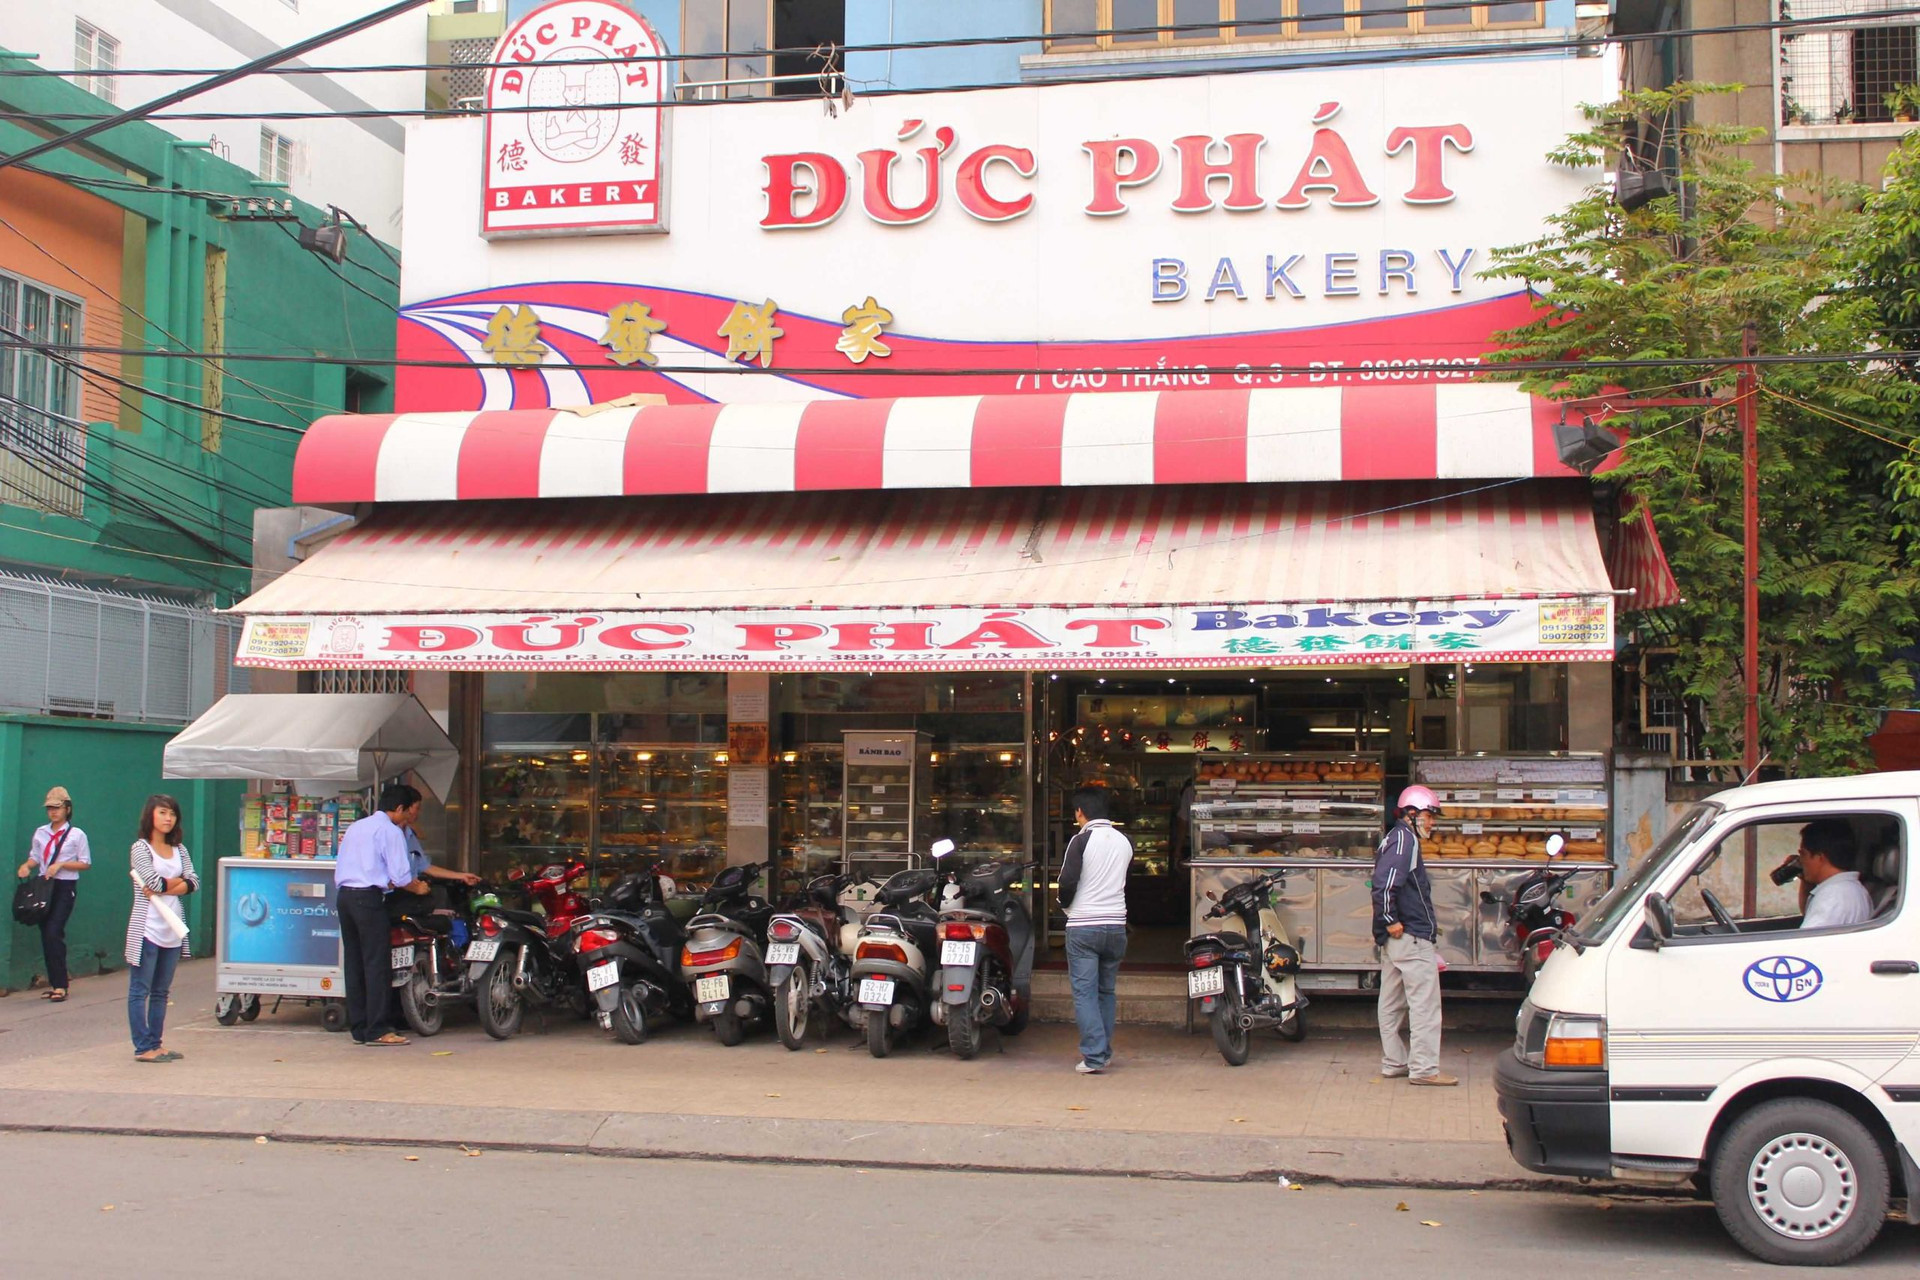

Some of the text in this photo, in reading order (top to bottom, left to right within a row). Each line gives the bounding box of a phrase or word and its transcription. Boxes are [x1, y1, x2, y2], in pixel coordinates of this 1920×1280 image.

[501, 16, 649, 94] ĐỨC PHÁT
[497, 139, 528, 172] 德
[618, 132, 648, 166] 發
[759, 101, 1476, 230] ĐỨC PHÁT
[495, 184, 648, 207] BAKERY
[1151, 248, 1477, 303] BAKERY
[1051, 367, 1108, 389] CAO
[377, 610, 1175, 651] ĐỨC PHÁT
[1191, 607, 1520, 630] Bakery
[769, 952, 793, 962] 6778
[864, 991, 888, 1003] 0324
